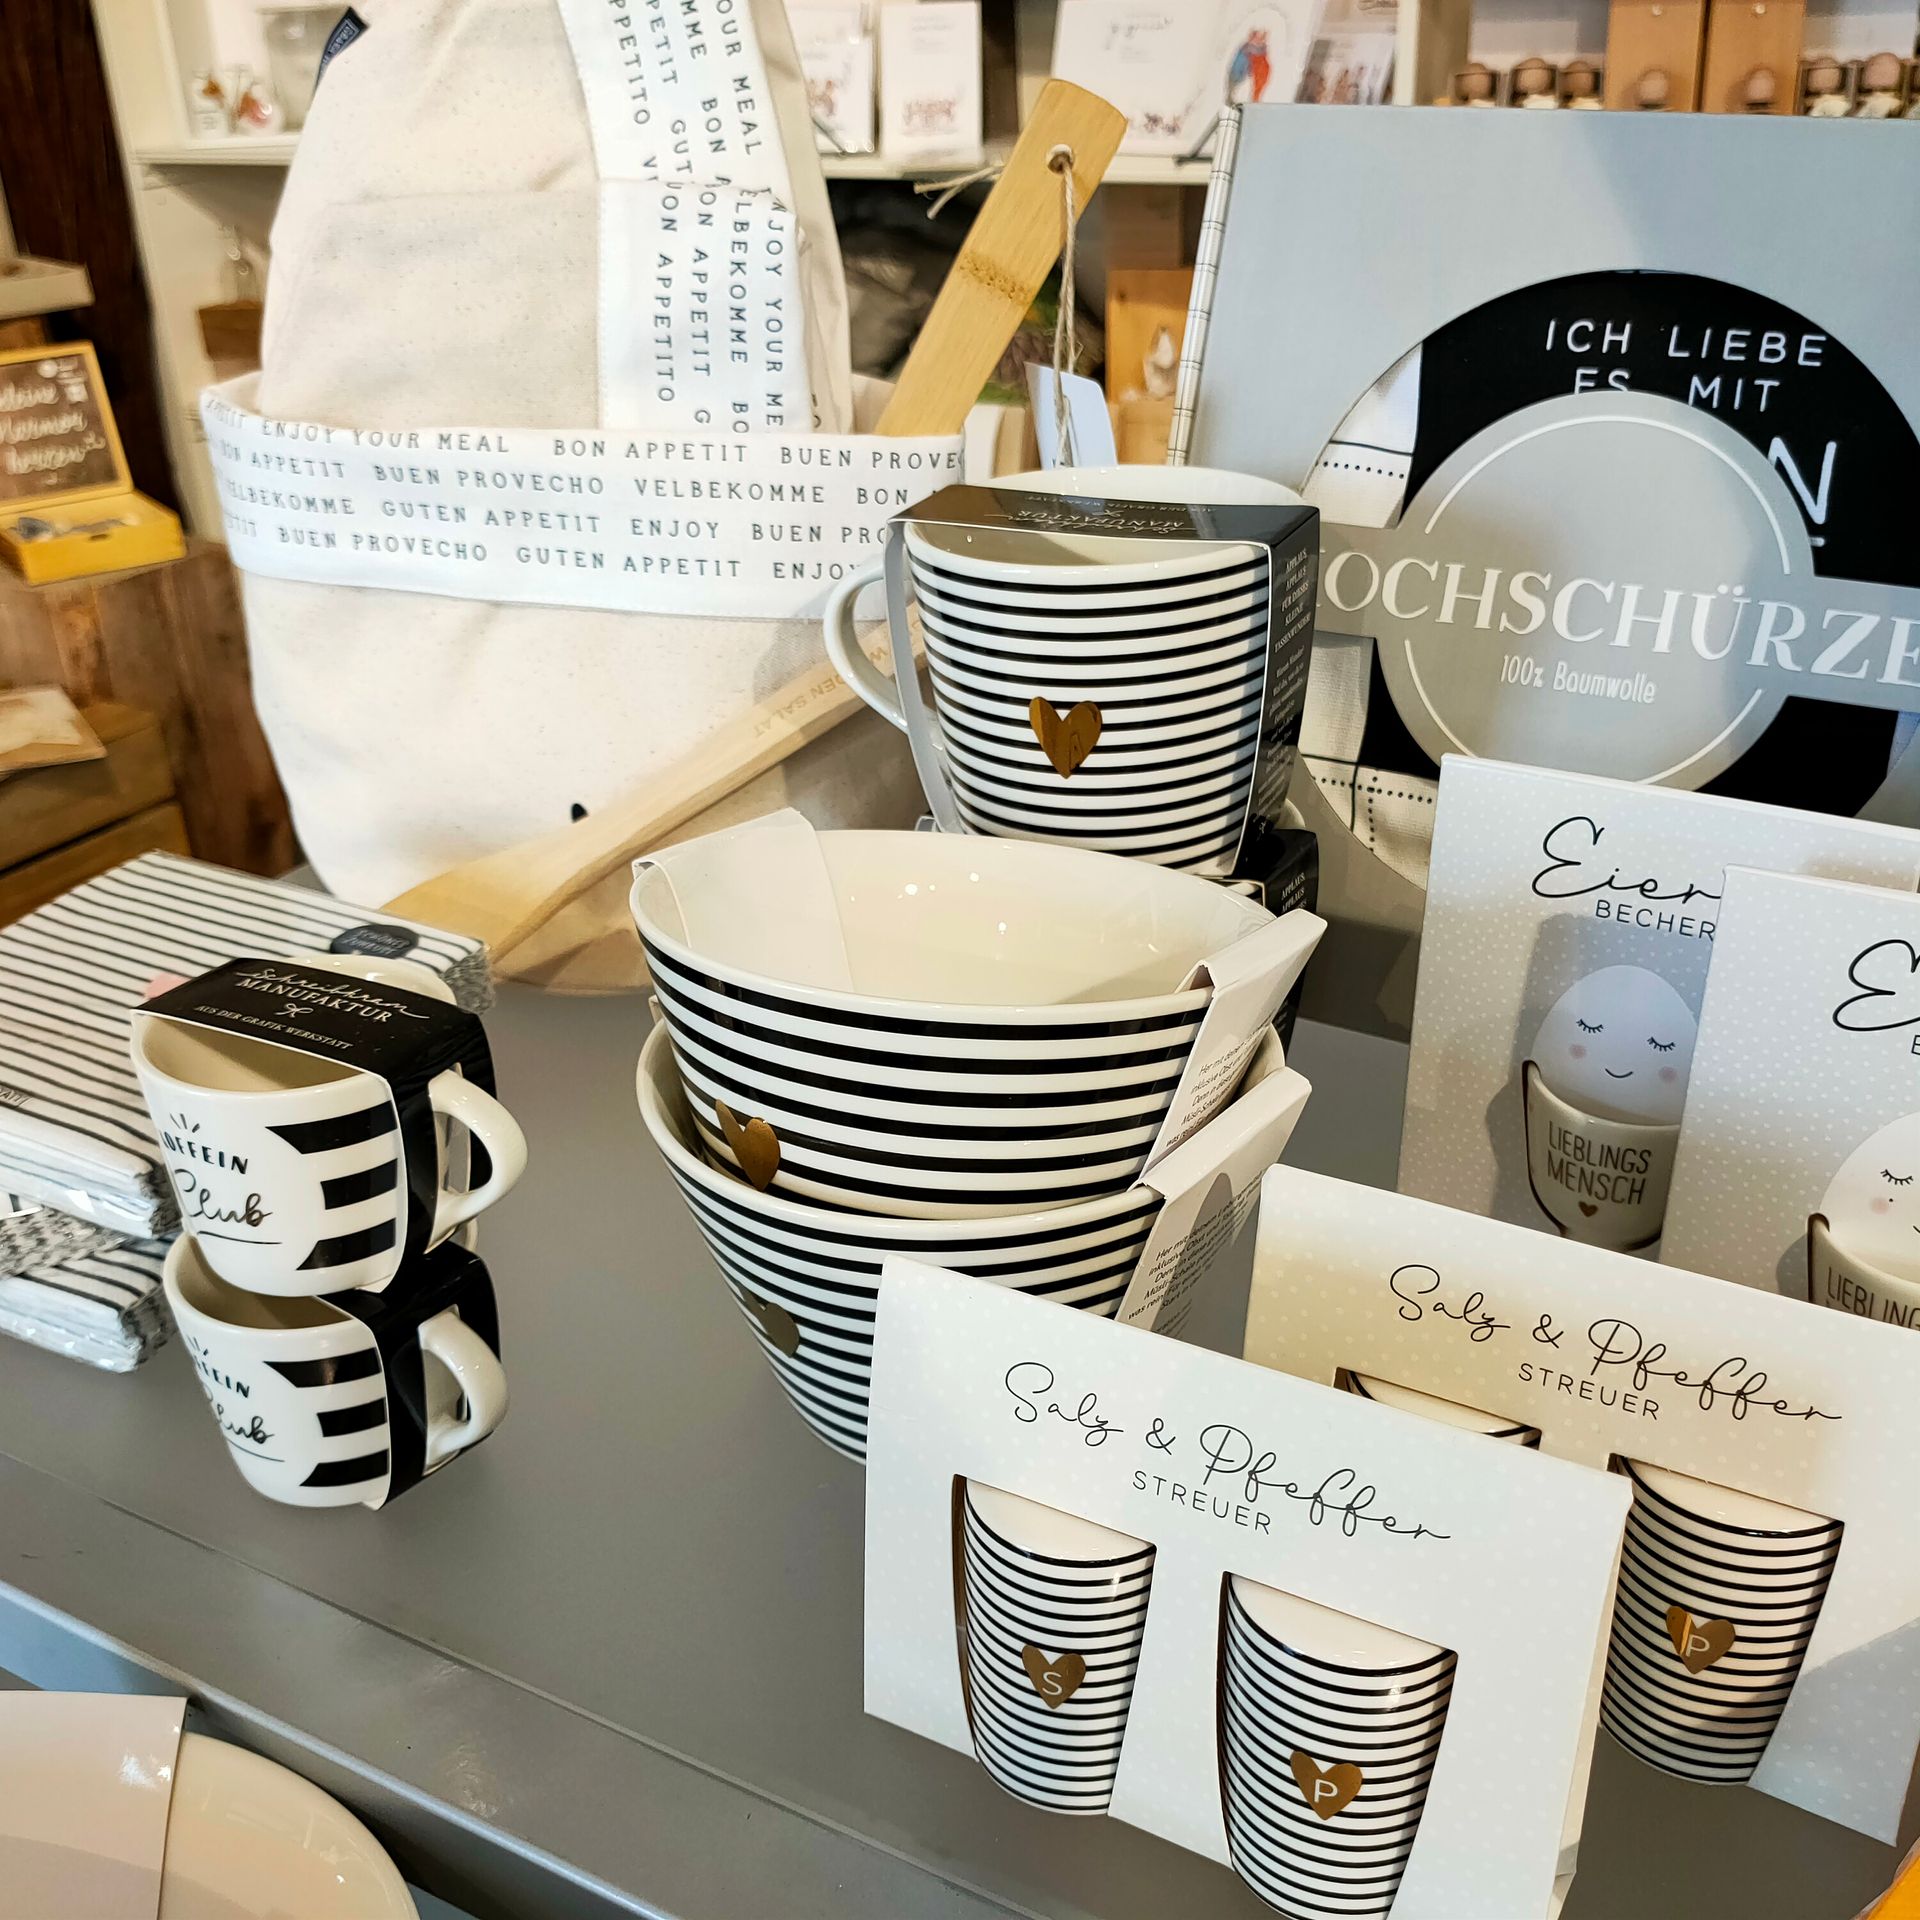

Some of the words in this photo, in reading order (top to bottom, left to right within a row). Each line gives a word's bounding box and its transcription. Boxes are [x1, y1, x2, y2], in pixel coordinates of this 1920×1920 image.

[701, 97, 727, 153] BON
[732, 75, 762, 156] MEAL
[654, 253, 676, 401] APPETITO
[690, 248, 711, 376] APPETIT
[765, 298, 783, 372] YOUR
[1546, 318, 1632, 354] ICH
[1668, 325, 1827, 367] LIEBE
[1688, 375, 1780, 413] MIT
[262, 419, 335, 445] ENJOY
[353, 430, 420, 449] YOUR
[438, 434, 509, 453] MEAL
[553, 438, 605, 457] BON
[625, 442, 747, 462] APPETIT
[780, 446, 851, 467] BUEN
[251, 452, 345, 478] APPETIT
[373, 465, 440, 485] BUEN
[457, 470, 604, 495] PROVECHO
[634, 478, 825, 503] VELBEKOMME
[856, 487, 909, 506] BON
[381, 501, 467, 523] GUTEN
[485, 510, 601, 533] APPETIT
[631, 518, 719, 539] ENJOY
[752, 523, 823, 543] BUEN
[278, 527, 338, 549] BUEN
[351, 533, 488, 561] PROVECHO
[516, 547, 605, 569] GUTEN
[623, 555, 741, 577] APPETIT
[1318, 550, 1920, 687] OCHSCHÜRZE
[1500, 654, 1544, 687] 100%
[1553, 660, 1656, 704] Baumwolle
[753, 695, 807, 738] SALAT
[1531, 816, 1721, 904] Eier
[1595, 899, 1716, 942] BECHER
[235, 968, 430, 1019] Schreibkram
[236, 978, 393, 1023] MANUFAKTUR
[216, 1009, 242, 1020] DER
[241, 1013, 287, 1032] GRAFIK
[285, 1025, 353, 1050] WERKSTATT
[1548, 1120, 1652, 1174] LIEBLINGS
[174, 1168, 273, 1227] Club
[1547, 1149, 1646, 1205] MENSCH
[1517, 1362, 1660, 1421] STREUER
[1532, 1313, 1565, 1349] &
[1587, 1318, 1843, 1421] Pfeffer
[1131, 1469, 1273, 1536] STREUER
[1144, 1417, 1176, 1456] &
[1199, 1423, 1451, 1541] Pfeffer
[1685, 1634, 1710, 1658] P
[1042, 1671, 1062, 1696] S
[1314, 1778, 1338, 1803] P
